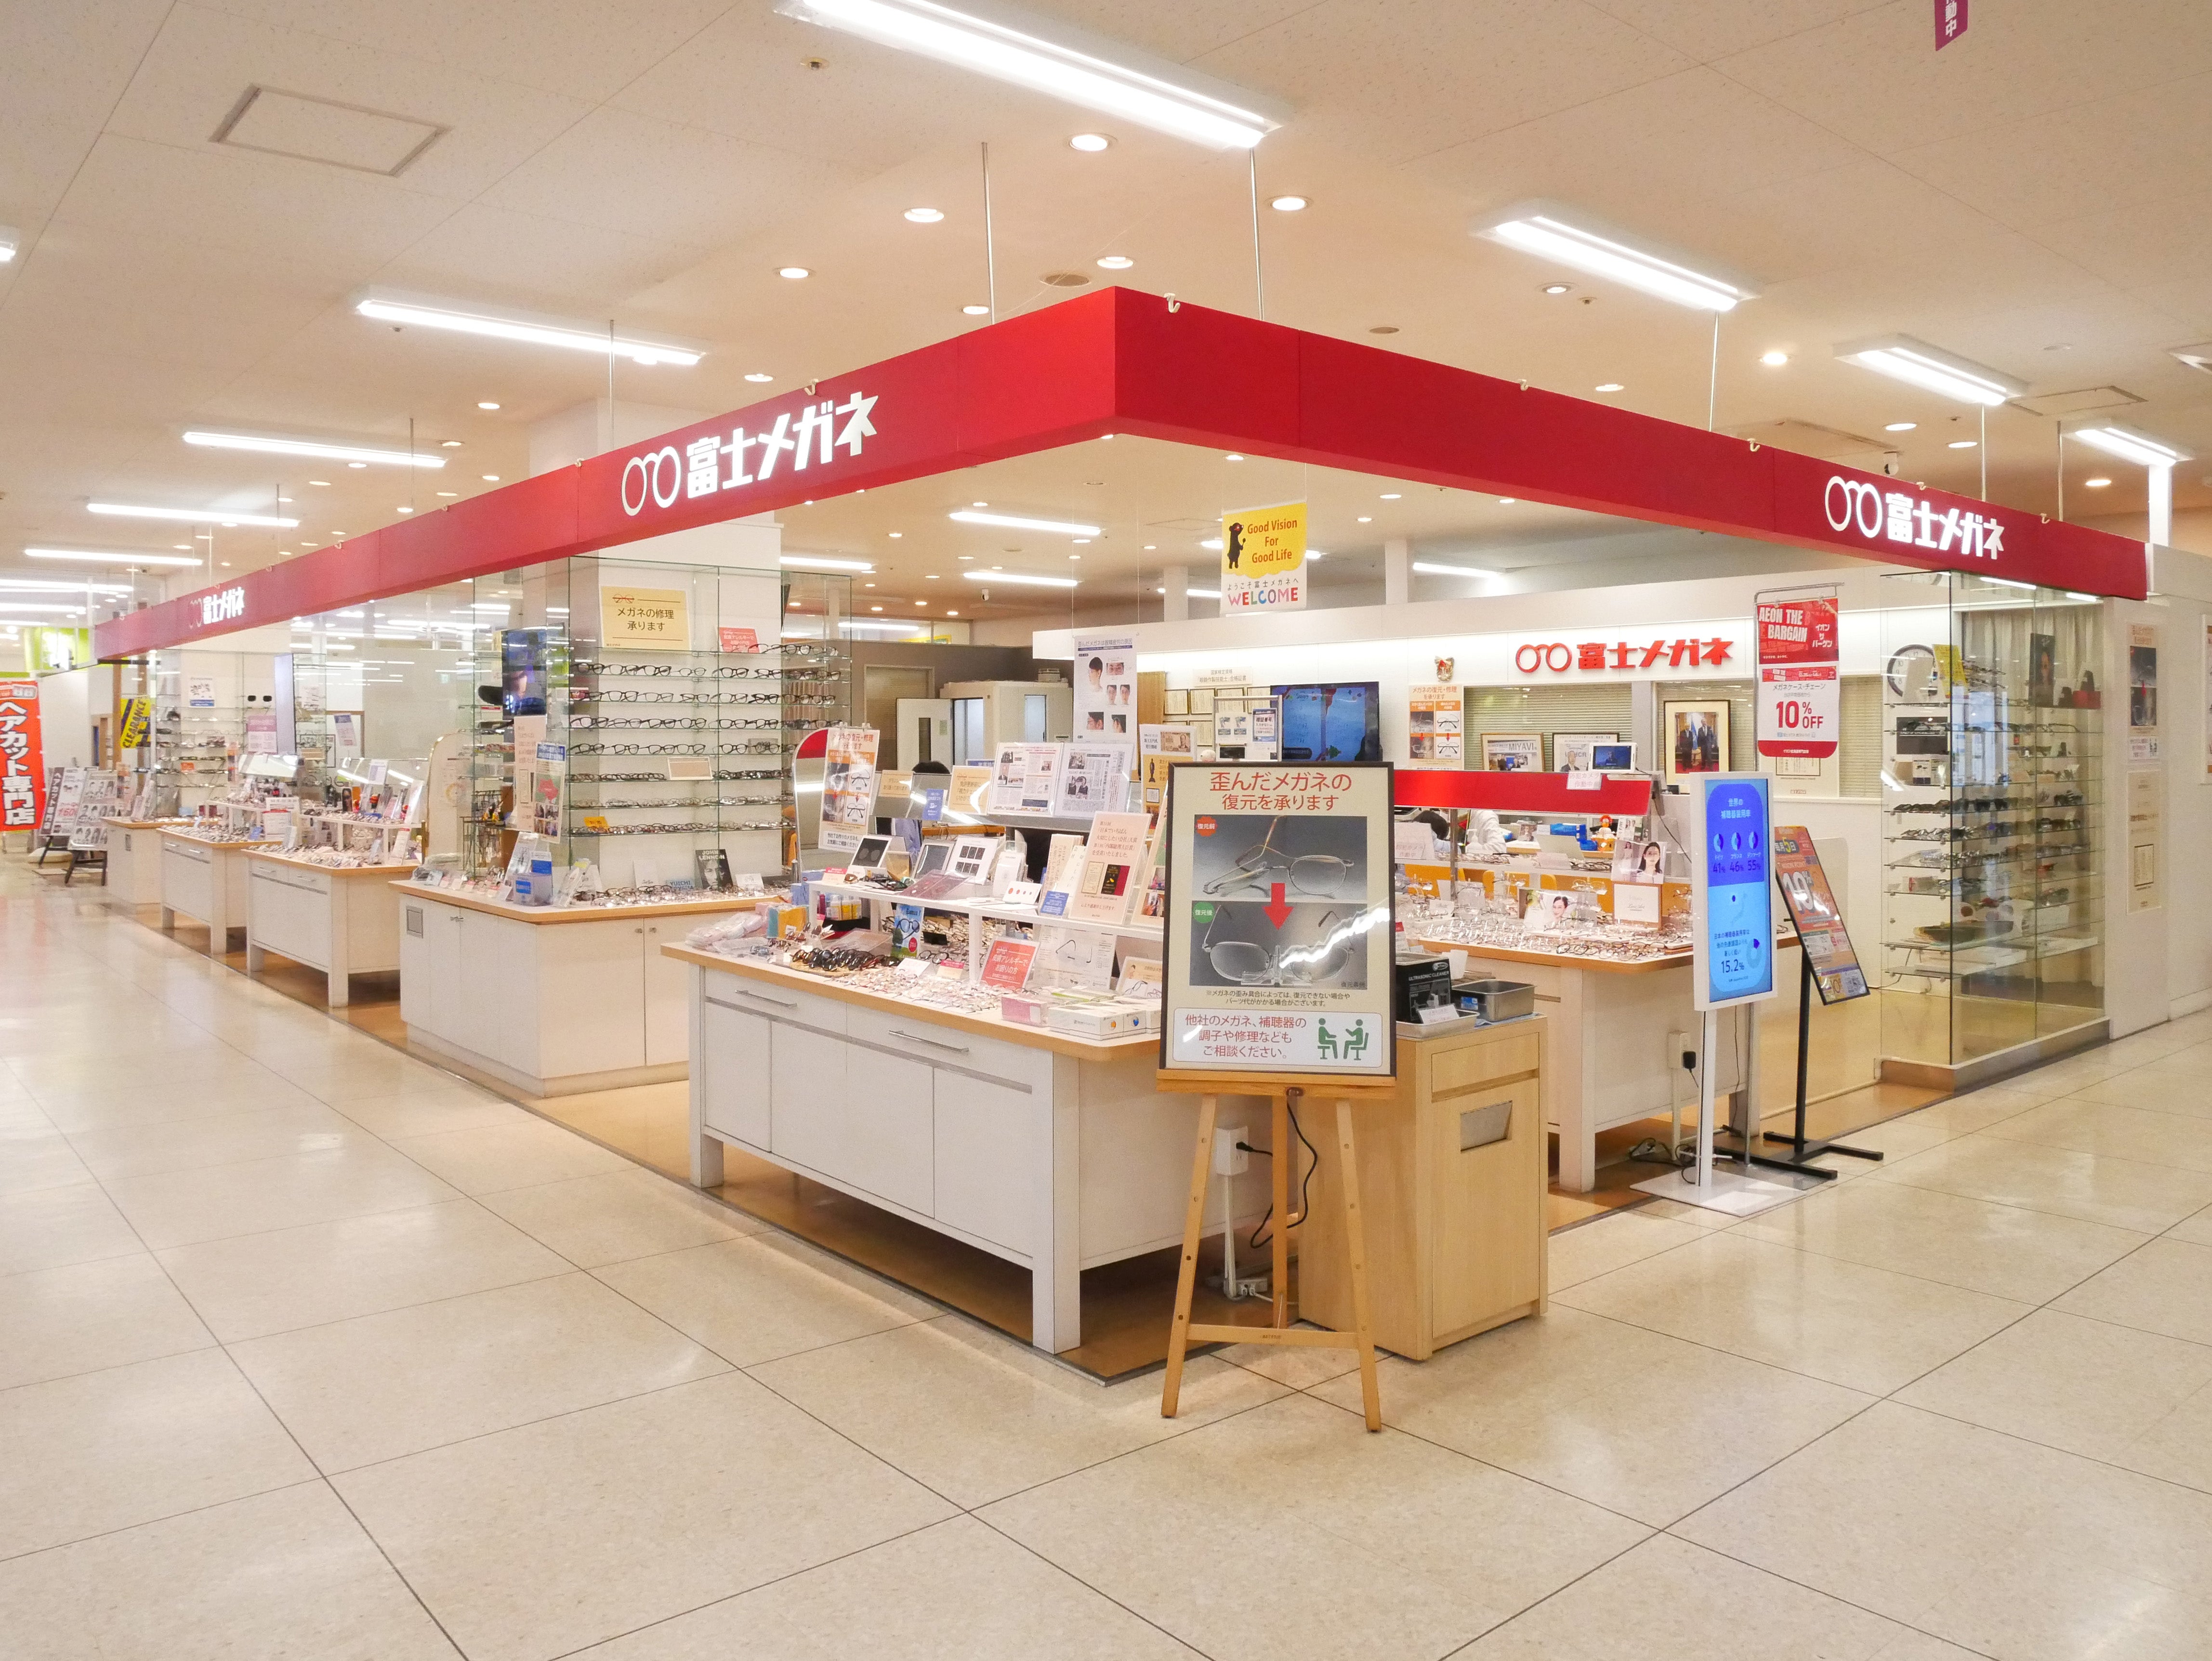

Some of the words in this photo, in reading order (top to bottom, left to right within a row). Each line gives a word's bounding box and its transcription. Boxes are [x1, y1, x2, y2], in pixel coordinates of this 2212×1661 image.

[687, 391, 879, 498] 富士メガネ
[1248, 521, 1269, 534] Good
[1271, 518, 1297, 531] Vision
[1886, 492, 2004, 560] 富士メガネ
[1265, 536, 1278, 547] For
[1252, 550, 1274, 563] Good
[1277, 549, 1292, 561] Life
[1227, 578, 1299, 591] ようこそ富士メガネへ
[1228, 587, 1298, 606] WELCOME
[203, 586, 245, 624] 富士メガネ
[617, 607, 674, 620] メガネの修理
[1759, 607, 1783, 623] AEON
[1786, 609, 1804, 625] THE
[627, 620, 665, 632] 承ります
[1768, 624, 1807, 642] BARGAIN
[1577, 637, 1734, 669] 富士メガネ
[1776, 700, 1799, 728] 10
[1803, 716, 1823, 728] OFF
[1508, 742, 1534, 751] MIYAVI
[0, 701, 36, 825] ヘアカット専門店
[1211, 772, 1352, 792] 歪んだメガネの
[1222, 794, 1339, 810] 復元を承ります
[995, 964, 1019, 975] お困りの方
[1721, 959, 1745, 973] 15.2%
[1185, 1014, 1307, 1028] 他社のメガネ、補聴器の
[1199, 1030, 1292, 1044] 調子や修理なども
[1203, 1045, 1288, 1059] ご相談ください。
